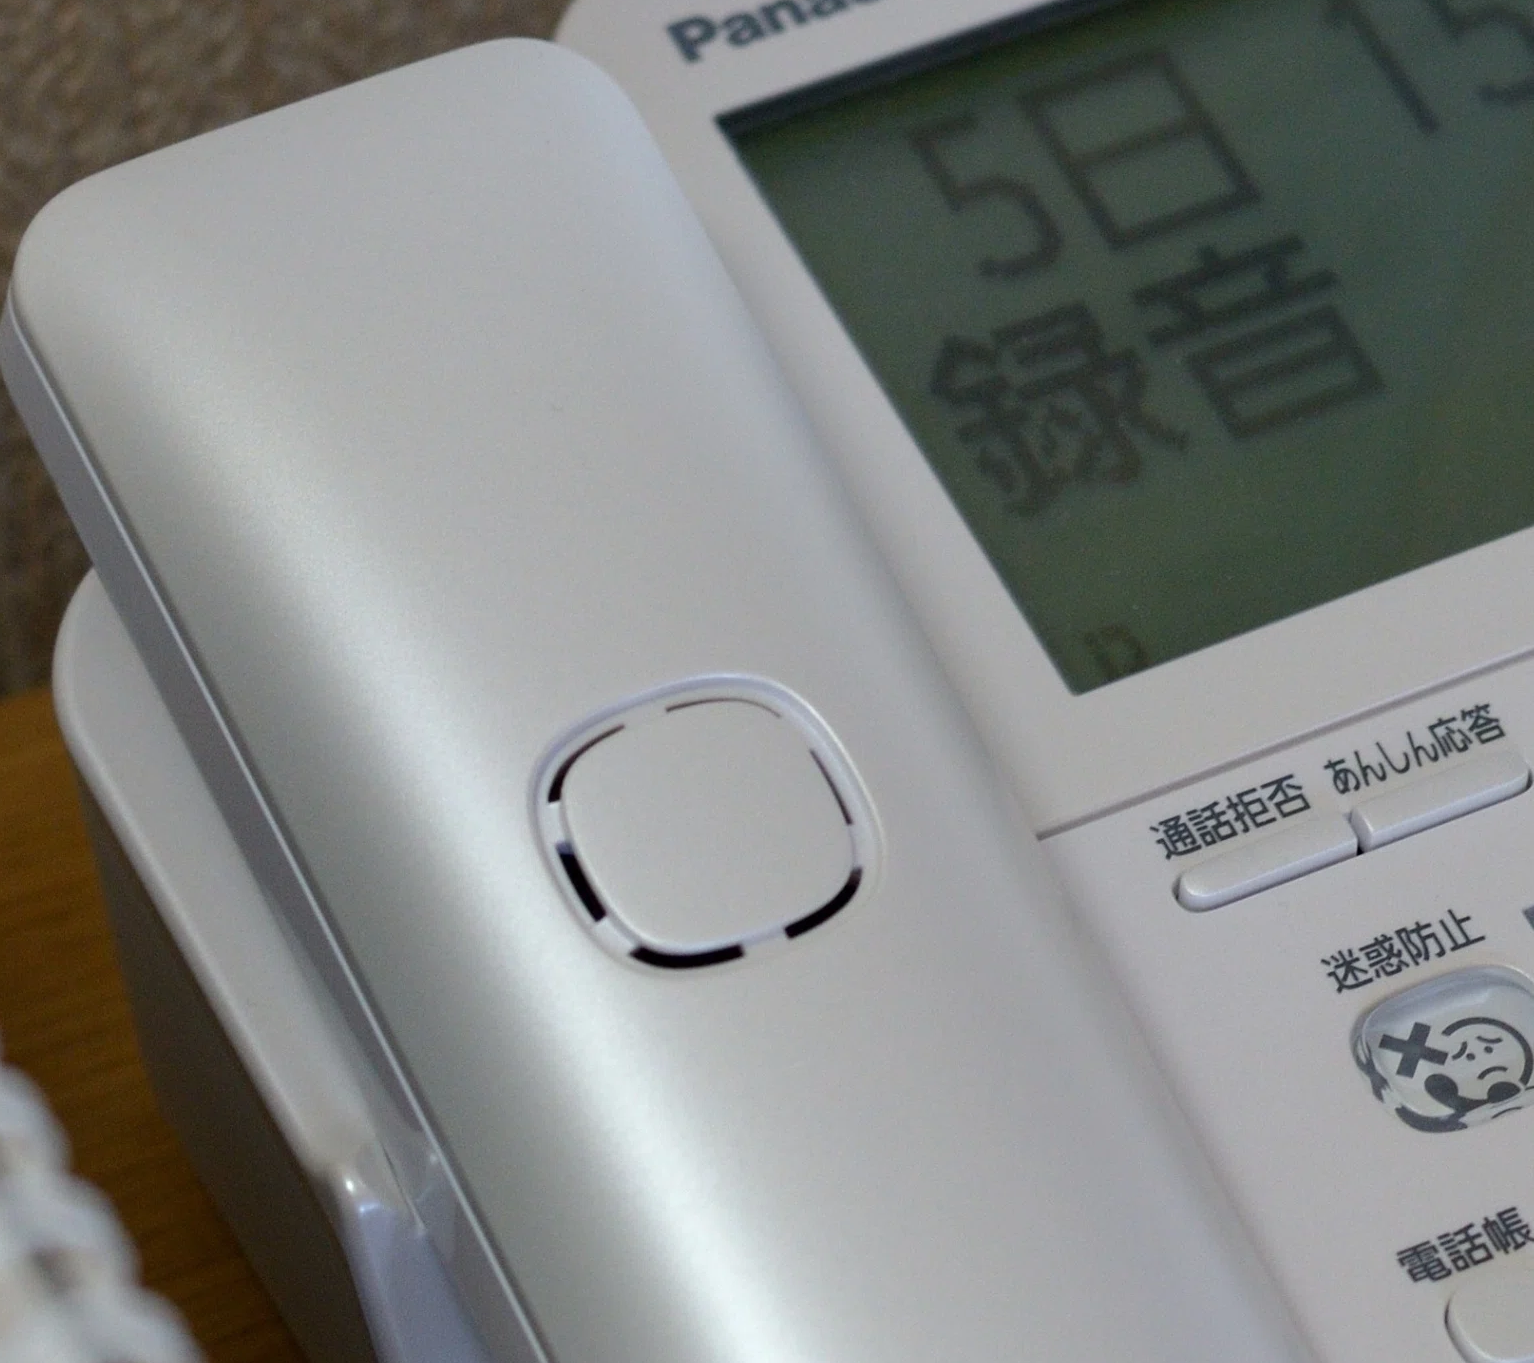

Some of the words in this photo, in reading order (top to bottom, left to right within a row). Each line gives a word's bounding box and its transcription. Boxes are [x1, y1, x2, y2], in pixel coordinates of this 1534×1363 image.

[911, 48, 1262, 279] 5日
[929, 234, 1382, 515] 録音
[1324, 704, 1506, 794] あんしん応答
[1149, 774, 1311, 860] 通話拒否
[1321, 908, 1485, 993] 迷惑防止
